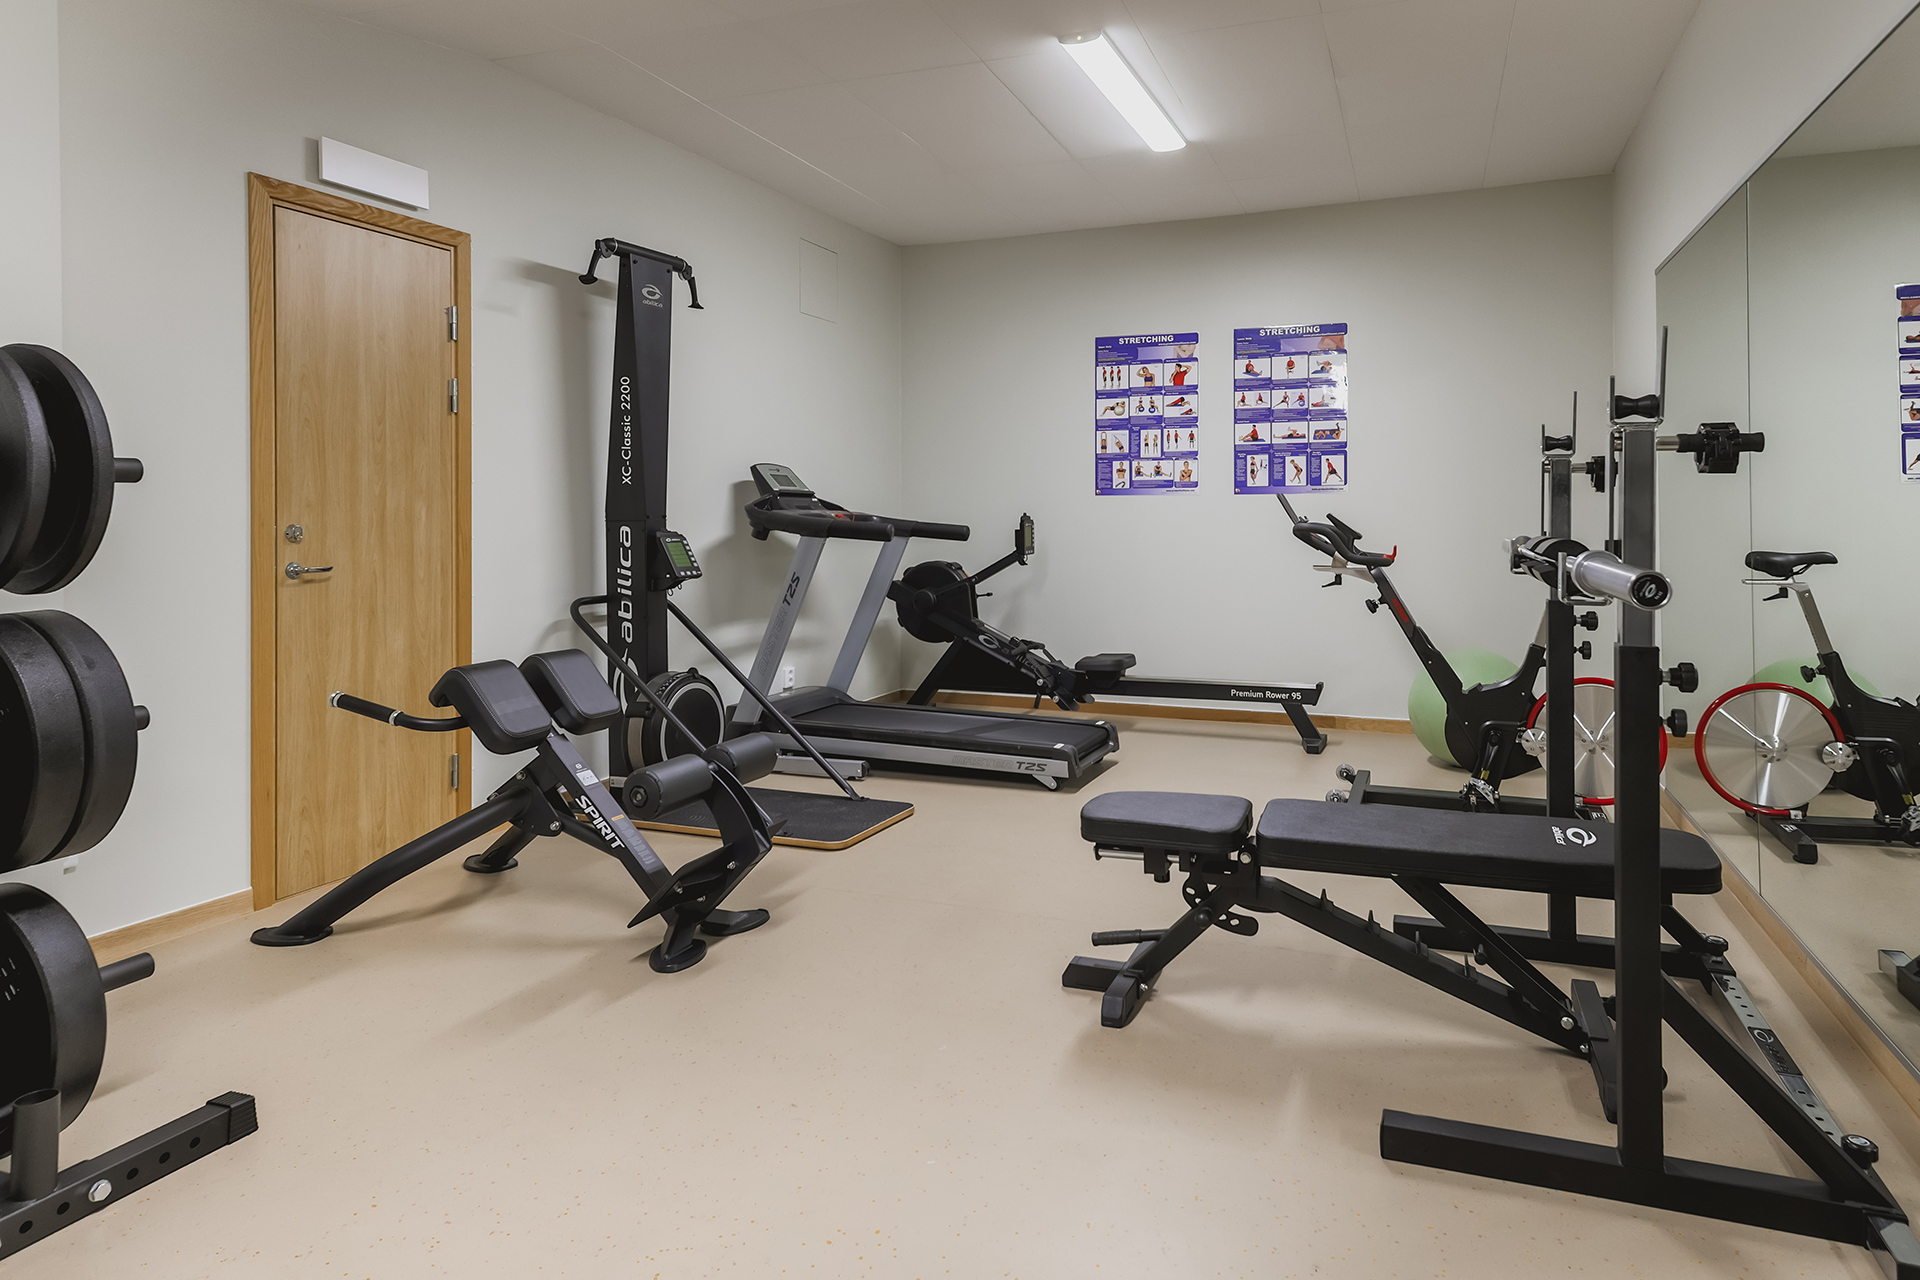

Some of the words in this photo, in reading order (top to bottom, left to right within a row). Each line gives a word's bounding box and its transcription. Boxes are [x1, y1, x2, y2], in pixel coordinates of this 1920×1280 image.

[1118, 334, 1174, 345] STRETCHING
[1259, 325, 1320, 337] STRETCHING
[620, 376, 631, 410] 2200
[621, 415, 632, 485] XC-Classic
[617, 525, 633, 644] abilica
[1391, 598, 1410, 622] KEISER
[1230, 688, 1264, 699] Premium
[1265, 690, 1289, 700] Rower
[1291, 691, 1302, 700] 95
[951, 754, 1014, 770] MASTER
[574, 795, 625, 848] SPIRIT
